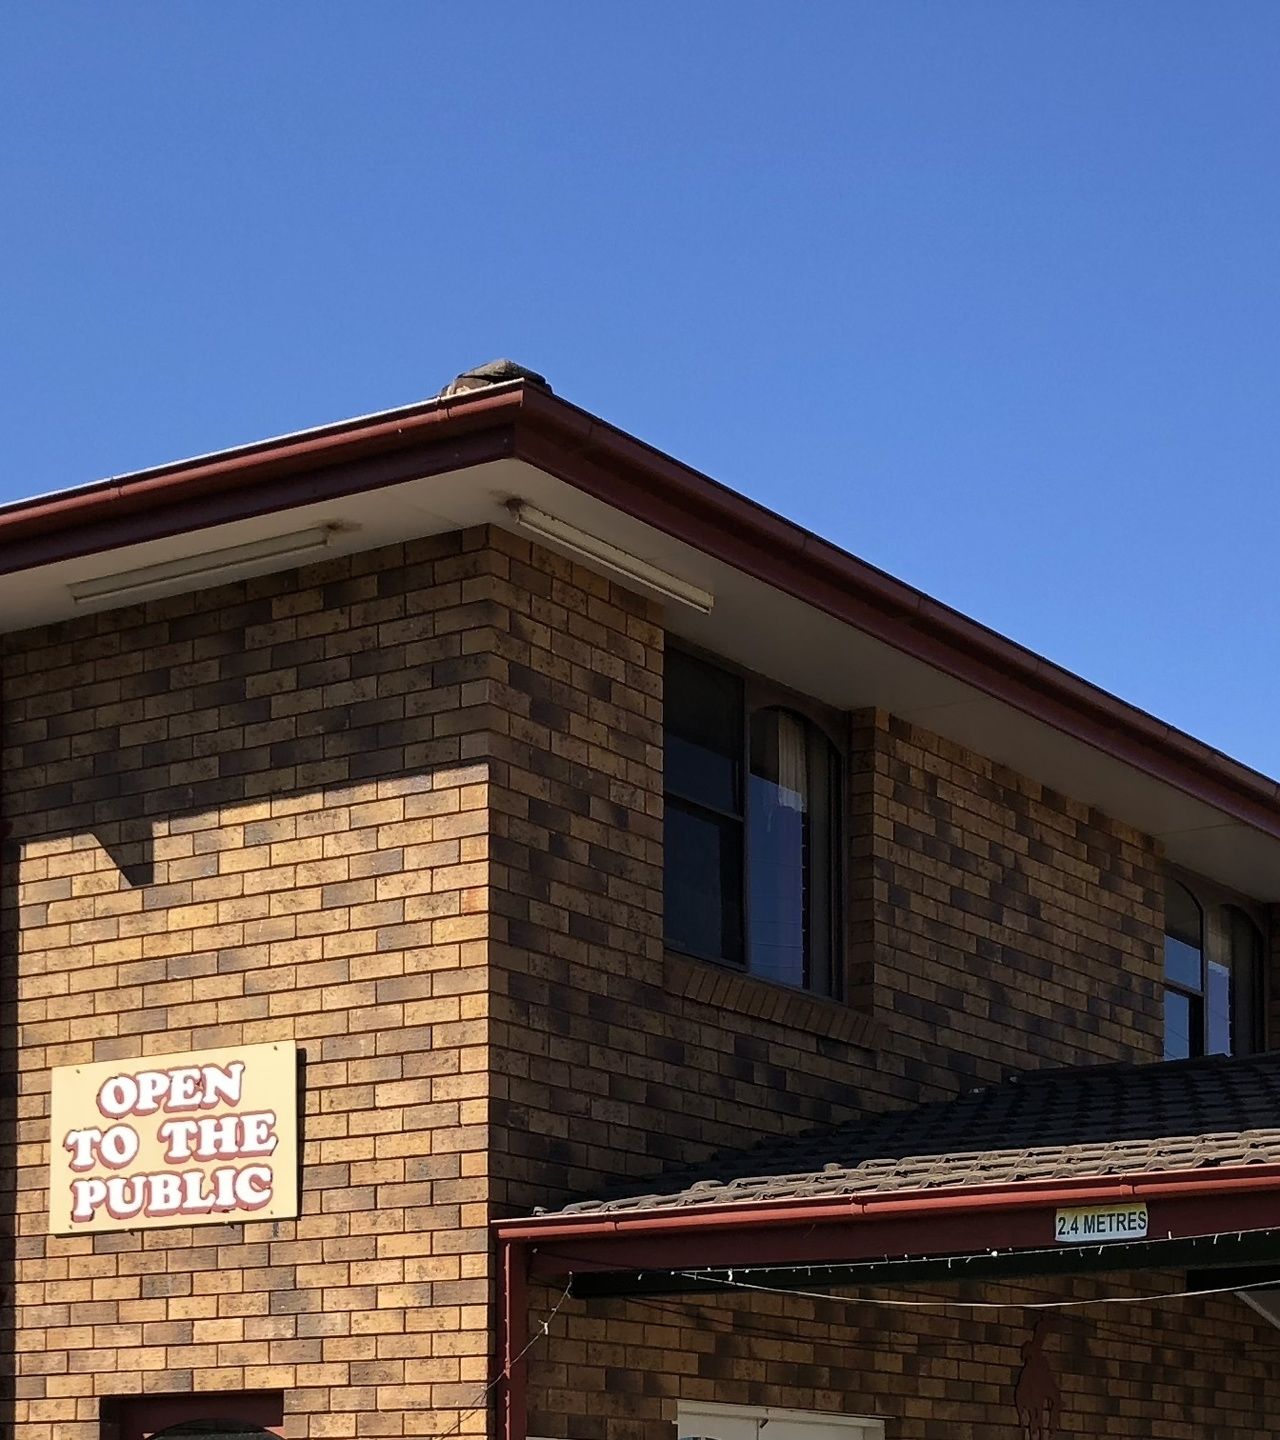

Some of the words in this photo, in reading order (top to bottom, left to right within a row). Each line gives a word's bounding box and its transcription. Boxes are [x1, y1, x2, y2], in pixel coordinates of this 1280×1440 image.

[96, 1060, 245, 1120] OPEN
[63, 1123, 139, 1172] TO
[157, 1109, 278, 1164] THE
[70, 1163, 273, 1222] PUBLIC
[1057, 1216, 1079, 1236] 2.4
[1083, 1211, 1147, 1234] METRES
